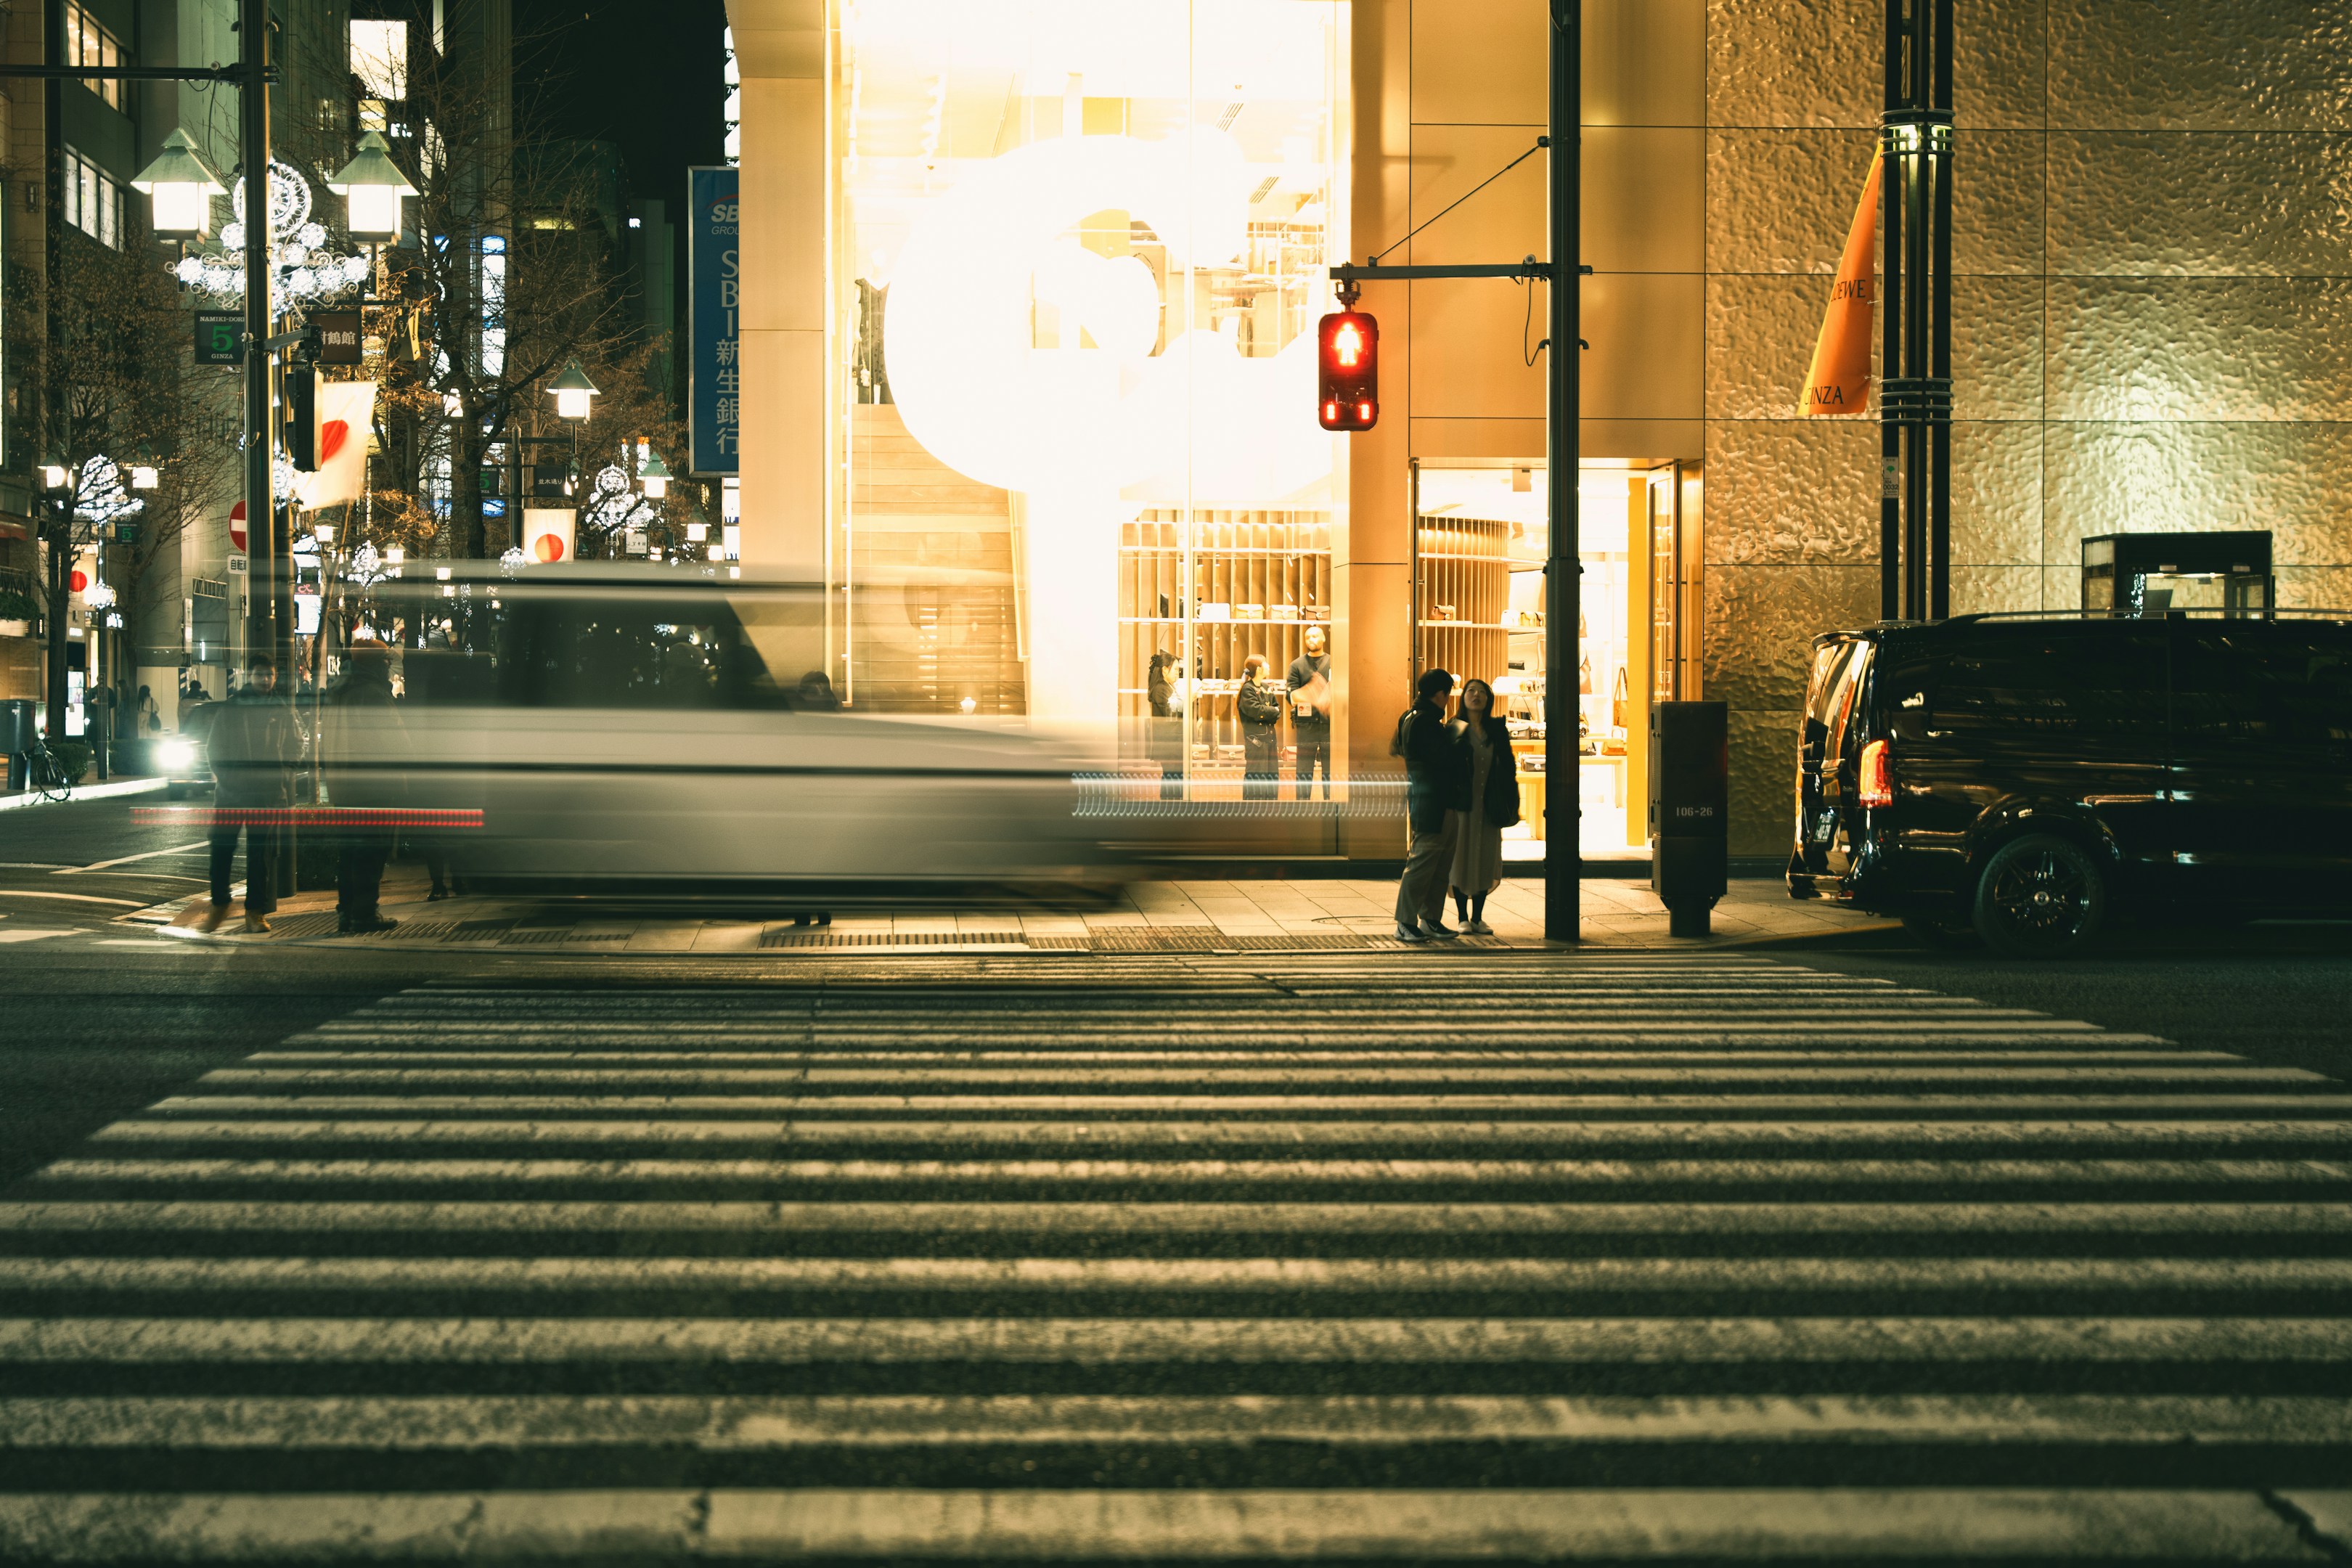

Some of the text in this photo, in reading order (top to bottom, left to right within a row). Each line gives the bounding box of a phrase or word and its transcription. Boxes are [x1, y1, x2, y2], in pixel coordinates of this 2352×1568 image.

[711, 204, 739, 223] SB
[711, 226, 739, 235] GROU
[211, 325, 234, 351] 5
[1676, 807, 1713, 817] 106-26
